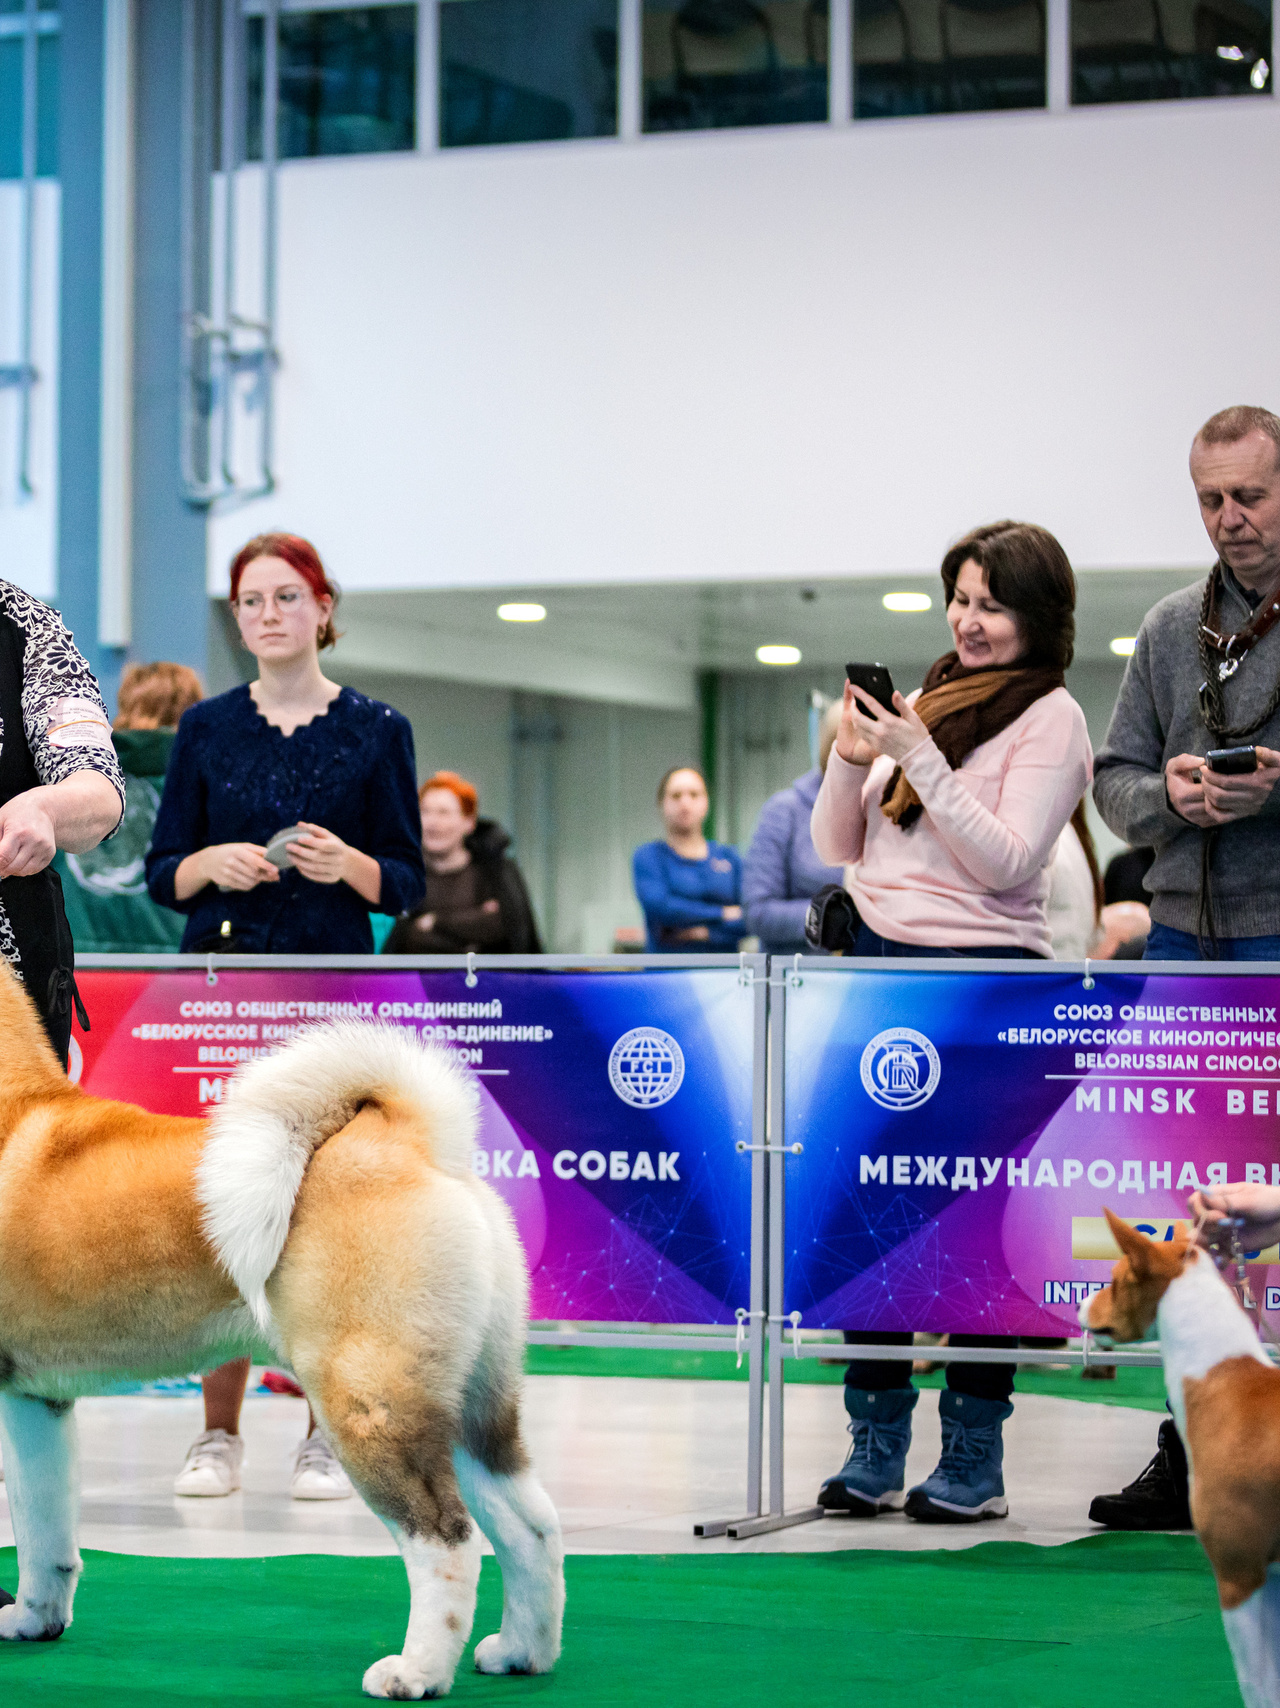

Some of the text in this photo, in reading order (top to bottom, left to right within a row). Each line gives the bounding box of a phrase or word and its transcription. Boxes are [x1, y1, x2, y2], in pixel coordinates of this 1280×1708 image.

[179, 999, 503, 1020] СОЮЗ ОБЩЕСТВЕННЫХ ОБЪЕДИНЕНИЙ
[1053, 1004, 1277, 1024] СОЮЗ ОБЩЕСТВЕННЫХ
[421, 1025, 554, 1044] ОБЪЕДИНЕНИЕ»
[997, 1027, 1143, 1045] «БЕЛОРУССКОЕ
[630, 1060, 662, 1074] FCI
[1074, 1052, 1280, 1071] BELORUSSIAN CINOLO
[1075, 1086, 1196, 1114] MINSK
[552, 1149, 681, 1181] СОБАК
[860, 1155, 1228, 1194] МЕЖДУНАРОДНАЯ
